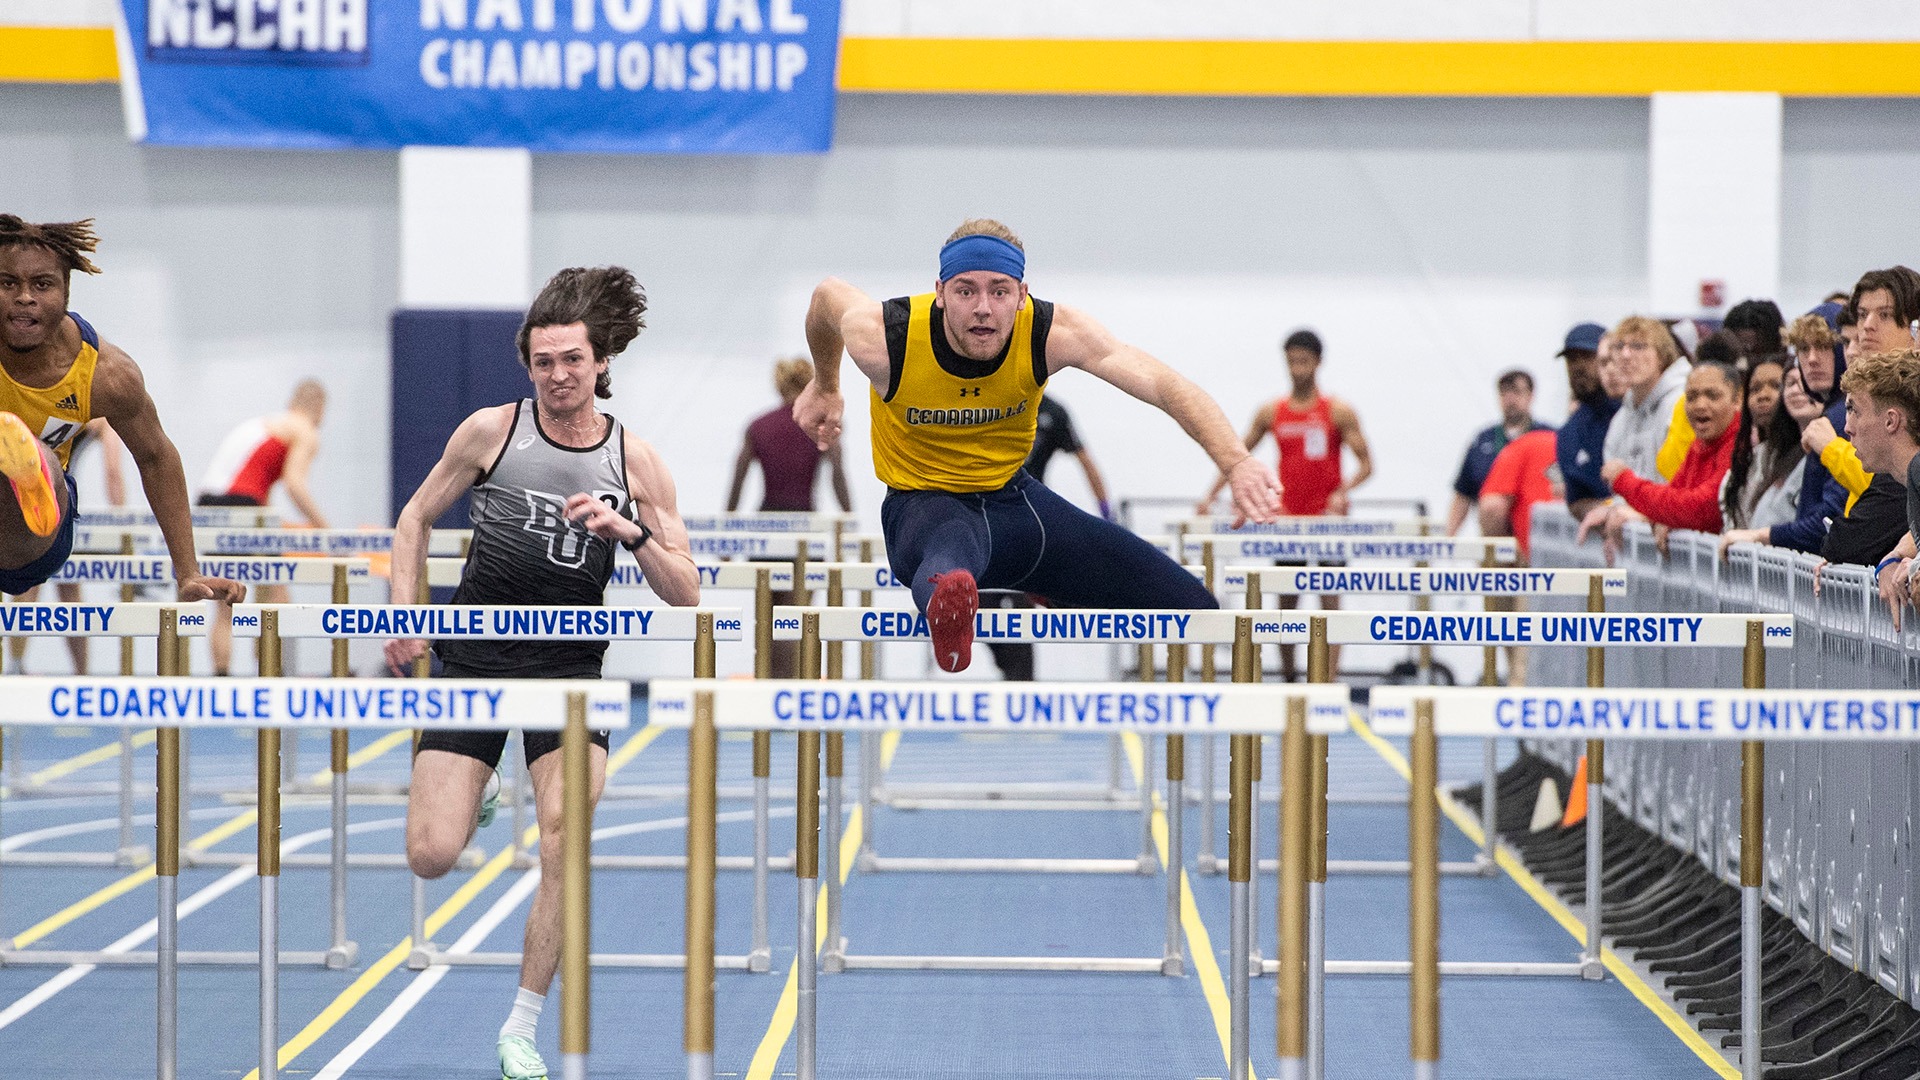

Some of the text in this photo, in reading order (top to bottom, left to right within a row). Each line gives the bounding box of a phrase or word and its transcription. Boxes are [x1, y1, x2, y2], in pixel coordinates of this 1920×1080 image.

[419, 38, 808, 92] CHAMPIONSHIP
[42, 423, 74, 450] 4
[328, 536, 393, 550] UNIVER
[689, 538, 768, 553] IVERSITY
[1241, 540, 1455, 557] CEDARVILLE UNIVERSITY
[52, 560, 297, 581] DARVILLE IVERSITY
[1295, 572, 1420, 592] CEDARVILLE
[1429, 573, 1554, 592] UNIVERSITY
[322, 609, 483, 634] CEDARVILLE
[494, 610, 653, 635] UNIVERSITY
[861, 612, 1022, 638] CEDALLE
[1032, 614, 1191, 638] UNIVERSITY
[1370, 616, 1531, 641] CEDARVILLE
[1542, 618, 1702, 642] UNIVERSITY
[50, 686, 503, 719] CEDARVILLE UNIVERSITY
[773, 690, 1221, 724] CEDARVILLE UNIVERSITY
[1495, 698, 1713, 730] CEDARVILLE
